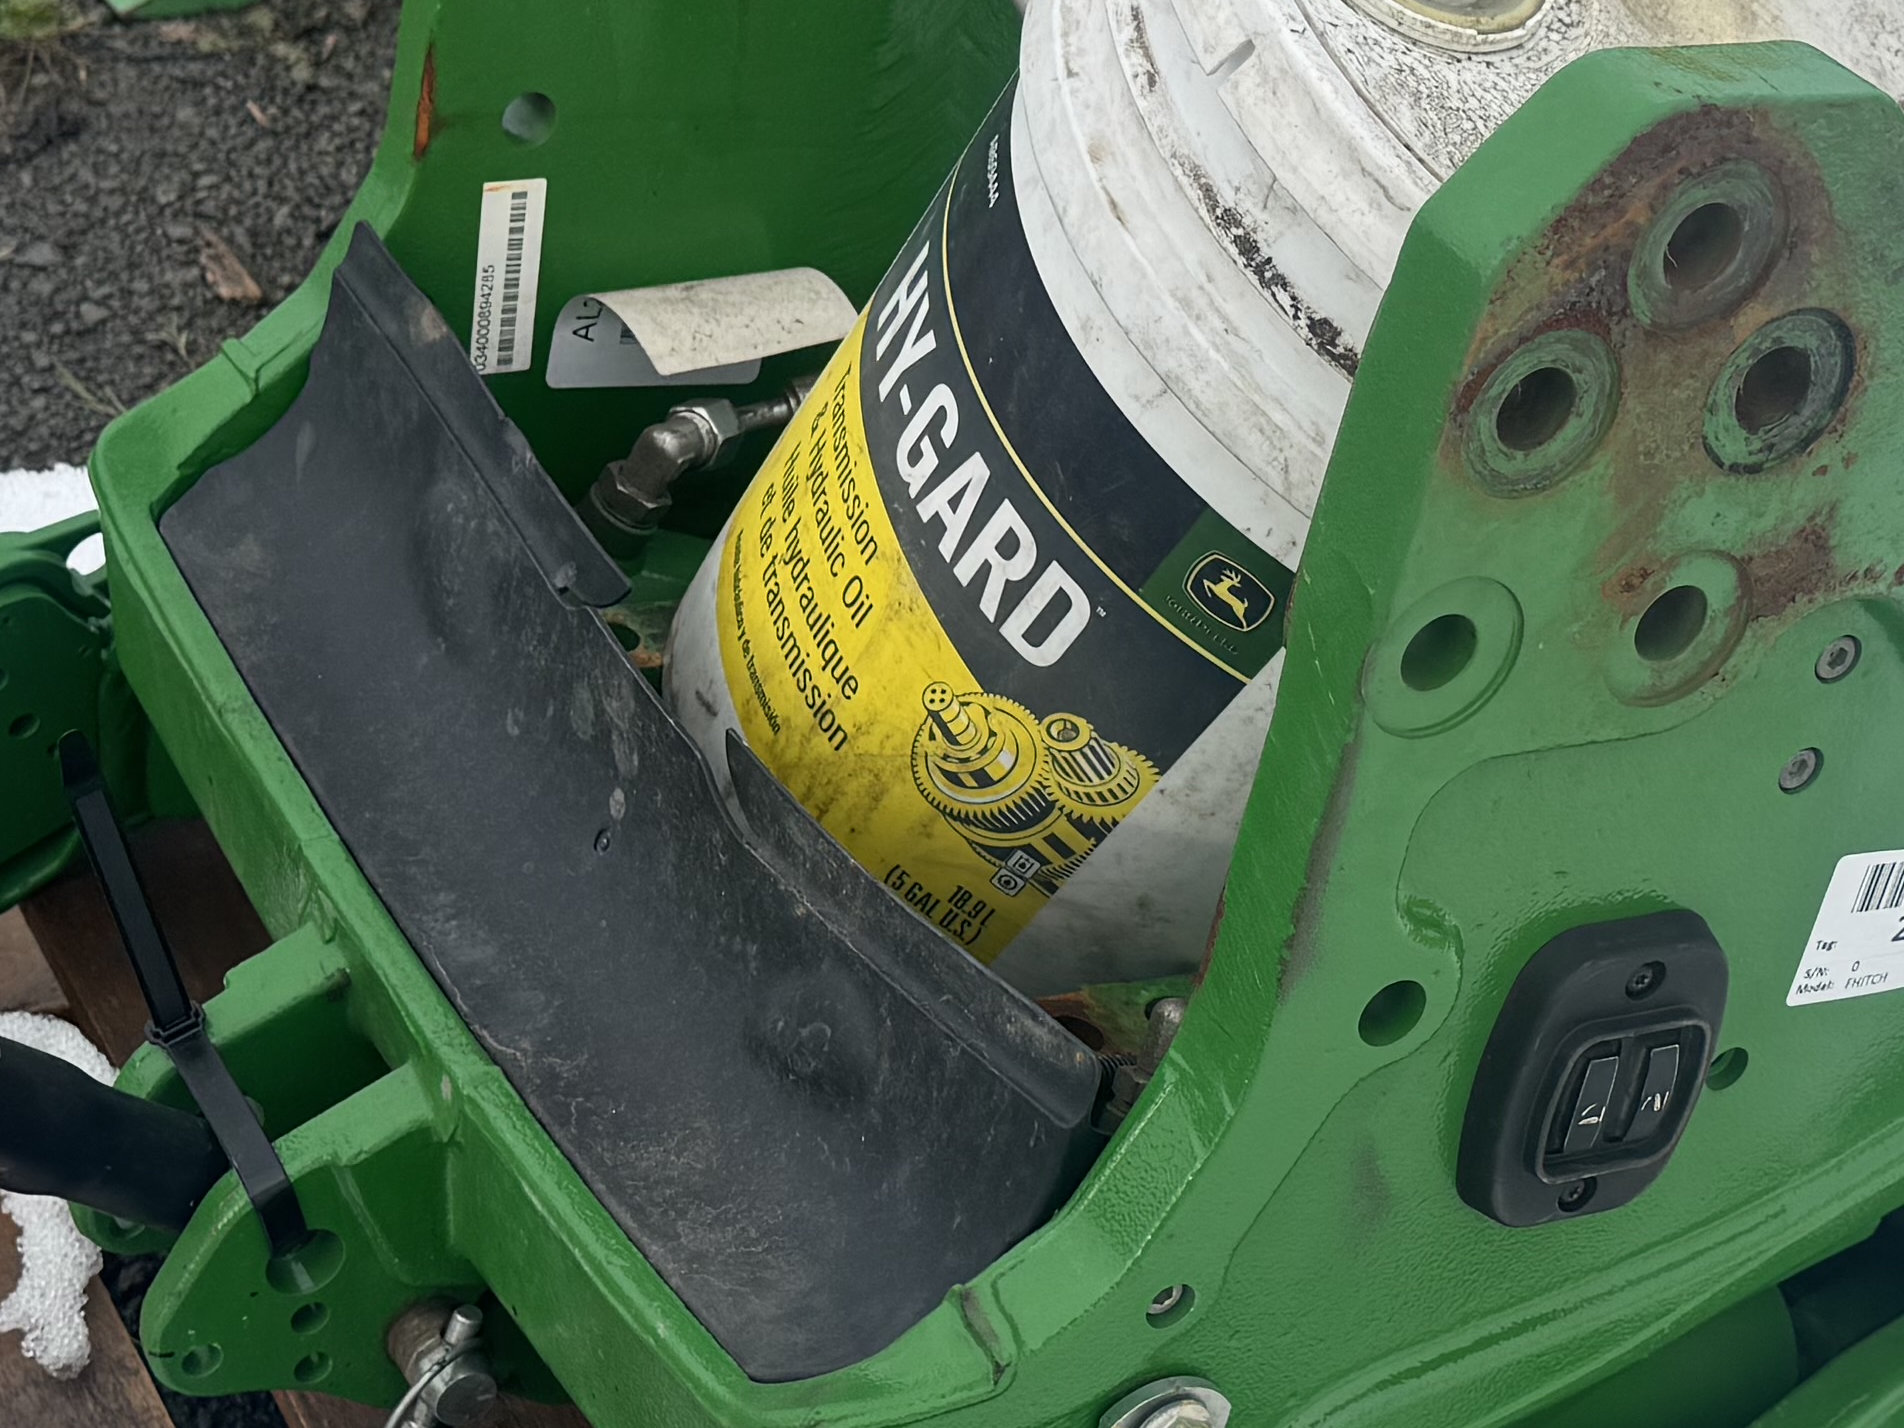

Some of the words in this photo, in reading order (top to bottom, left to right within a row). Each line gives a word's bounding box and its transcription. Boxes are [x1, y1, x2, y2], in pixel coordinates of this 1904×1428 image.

[810, 401, 829, 439] &
[875, 239, 1092, 667] HY-GARD
[759, 482, 777, 520] et
[781, 439, 802, 523] Huile
[805, 427, 846, 577] Hydraulic
[831, 362, 878, 567] Transmission
[759, 515, 777, 559] de
[782, 515, 859, 701] hydraulique
[841, 574, 874, 629] Oil
[762, 551, 849, 752] transmission
[883, 863, 911, 891] (5
[904, 881, 941, 919] GAL
[938, 907, 982, 946] U.S.)
[947, 884, 987, 919] 18.9
[1851, 960, 1861, 973] 0
